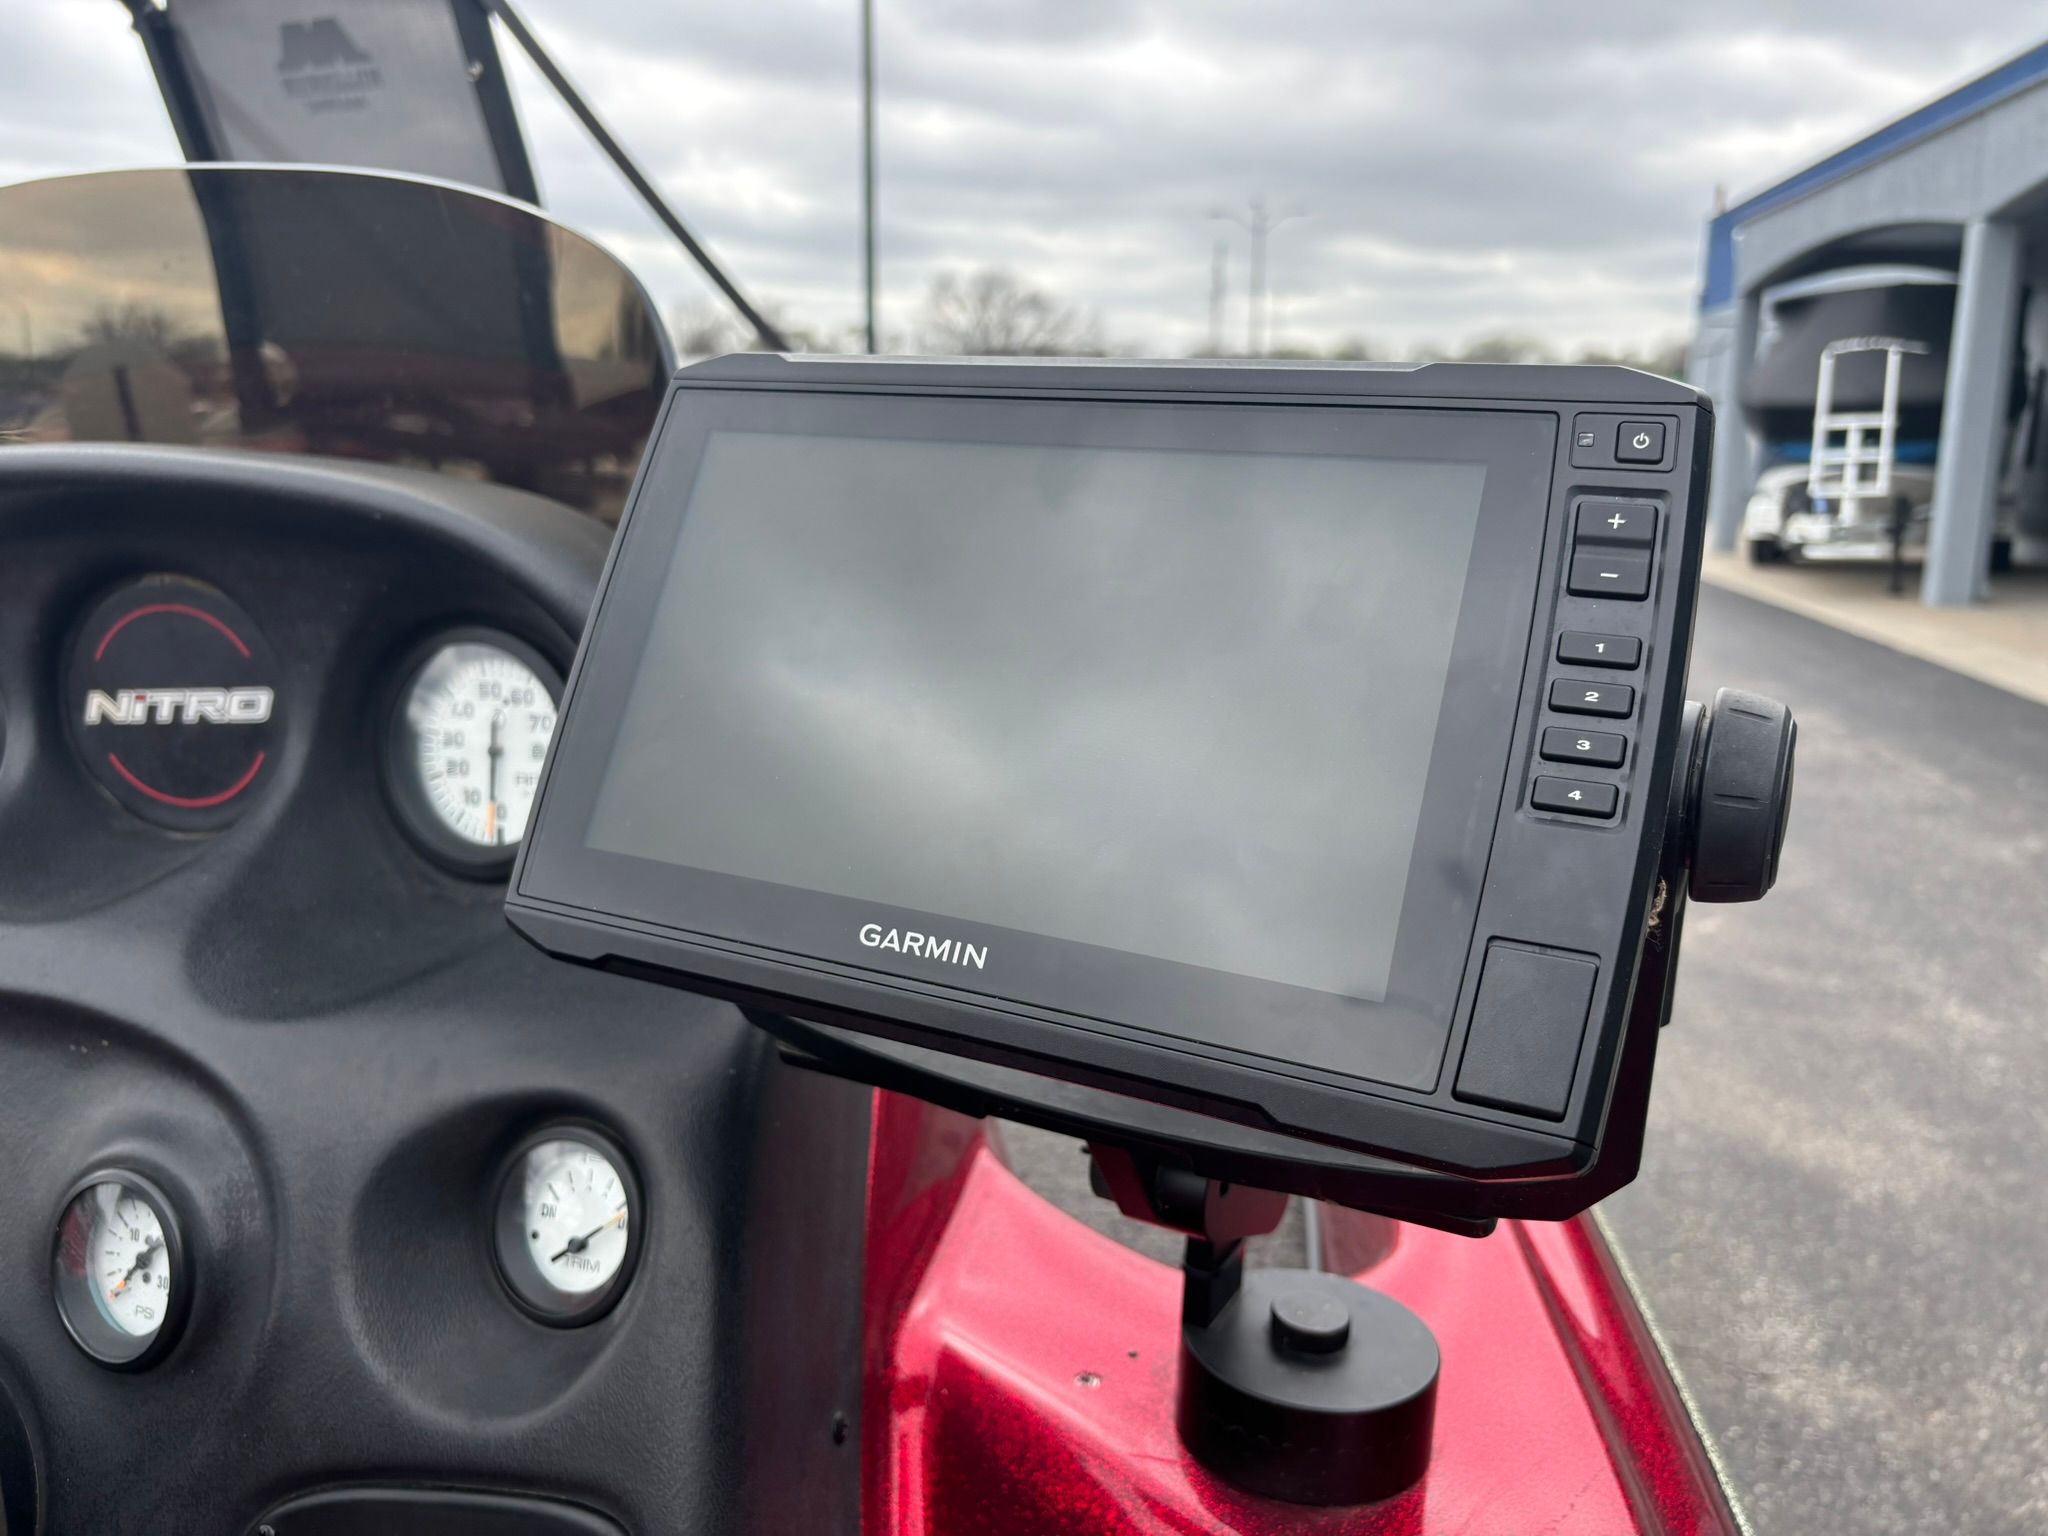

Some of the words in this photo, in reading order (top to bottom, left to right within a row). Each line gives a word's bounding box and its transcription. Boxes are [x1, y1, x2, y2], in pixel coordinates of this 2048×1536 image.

[1595, 643, 1605, 653] 1
[1584, 691, 1600, 702] 2
[1576, 740, 1591, 751] 3
[1567, 790, 1582, 801] 4
[859, 923, 988, 970] GARMIN
[129, 1227, 140, 1242] 10
[564, 1254, 601, 1273] TRIM
[157, 1274, 169, 1290] 30
[135, 1304, 155, 1320] PSI
